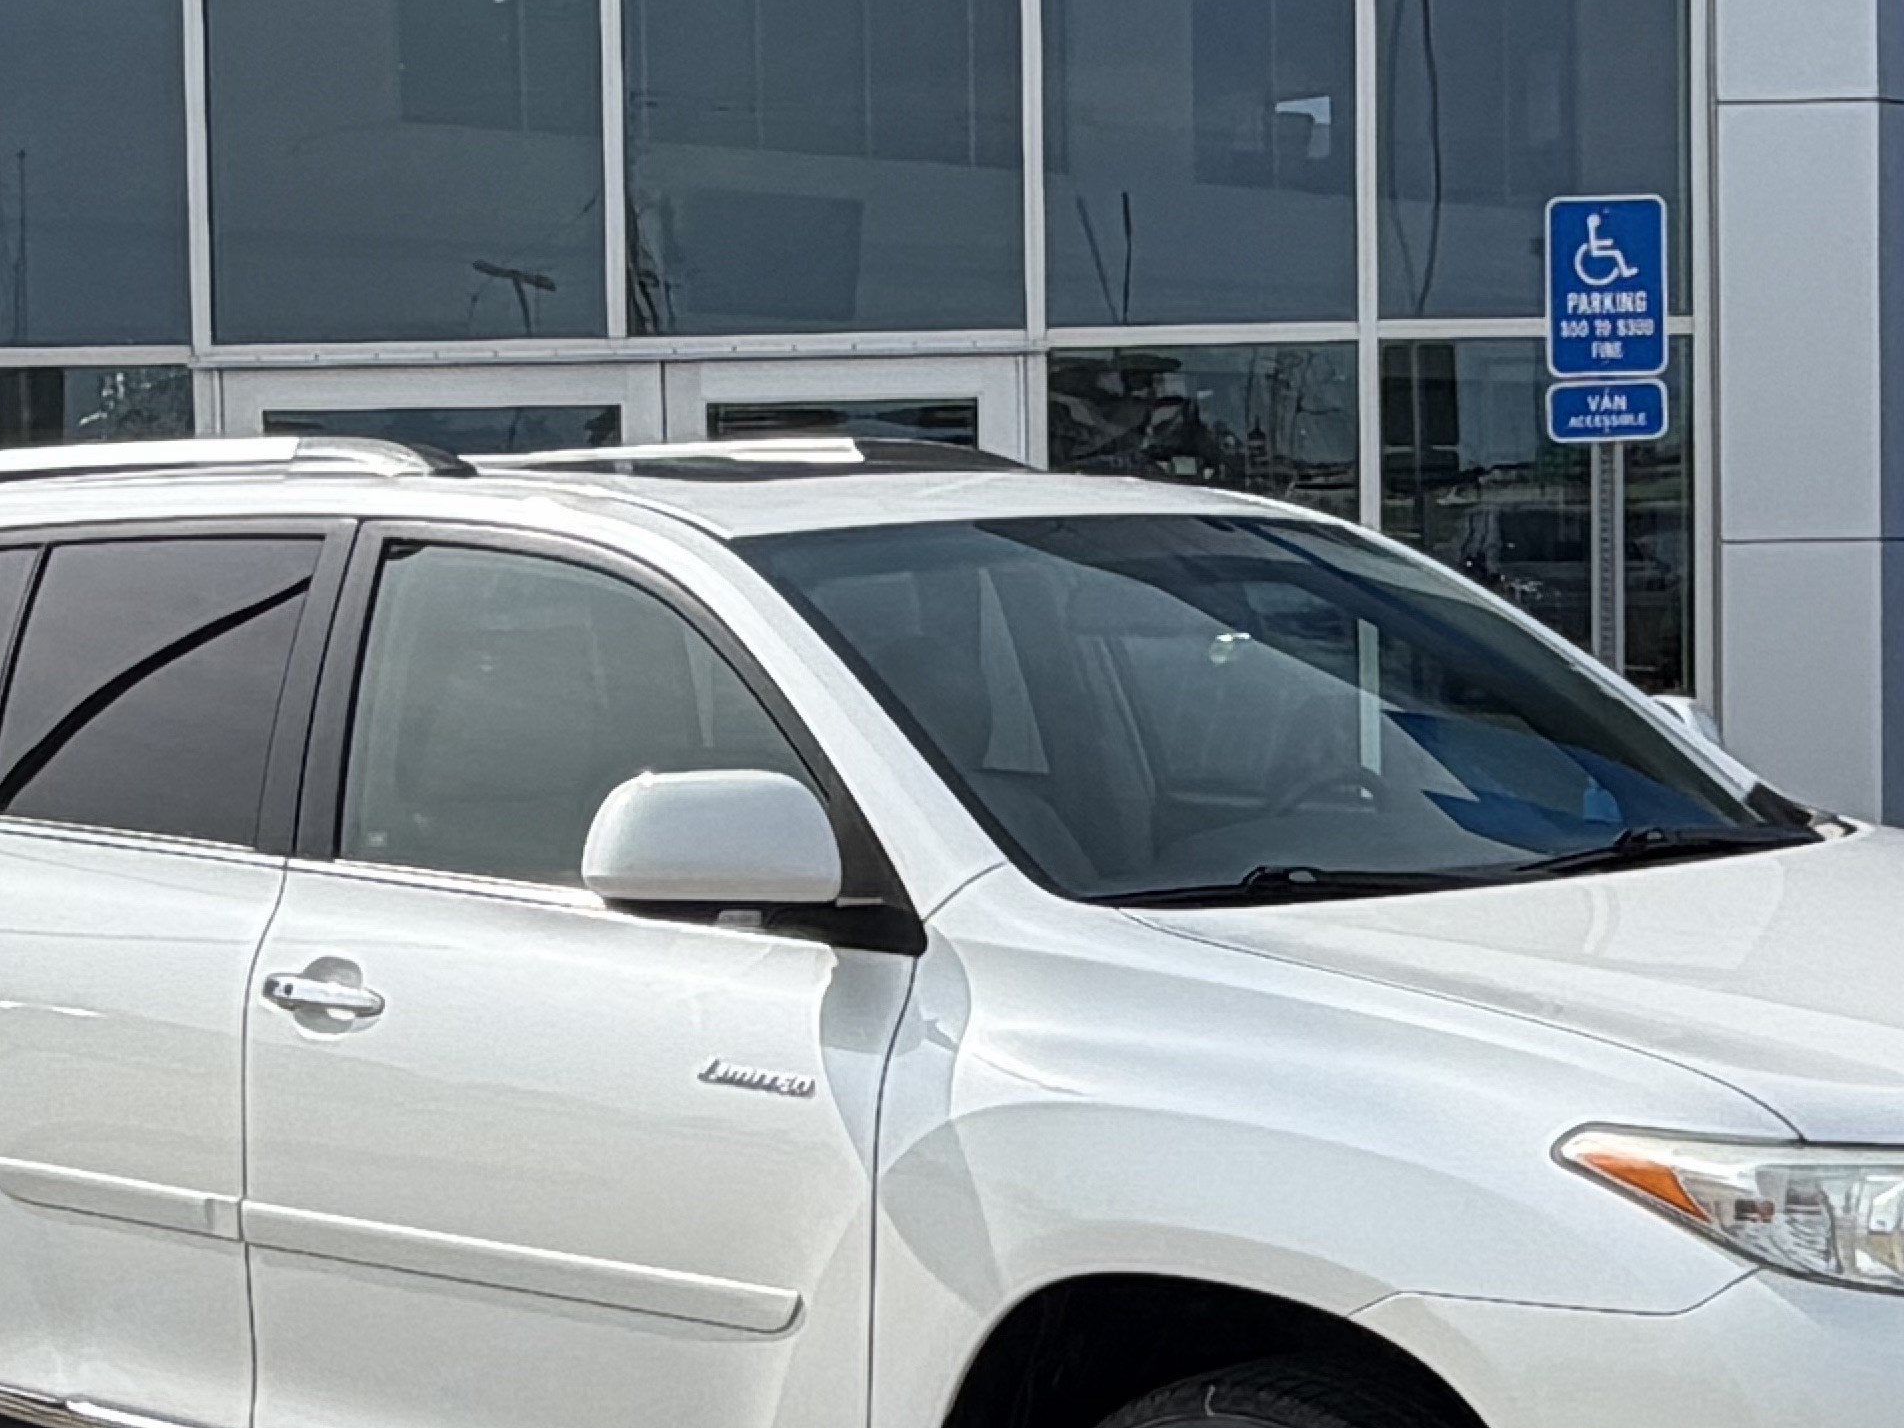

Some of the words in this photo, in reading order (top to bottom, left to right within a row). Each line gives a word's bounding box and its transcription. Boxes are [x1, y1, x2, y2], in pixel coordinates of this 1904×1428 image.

[1566, 291, 1647, 314] PARKING
[1594, 319, 1612, 337] TO
[1591, 341, 1623, 359] FINE
[1587, 394, 1627, 412] VAN
[1568, 412, 1647, 429] ACCESSIBLE
